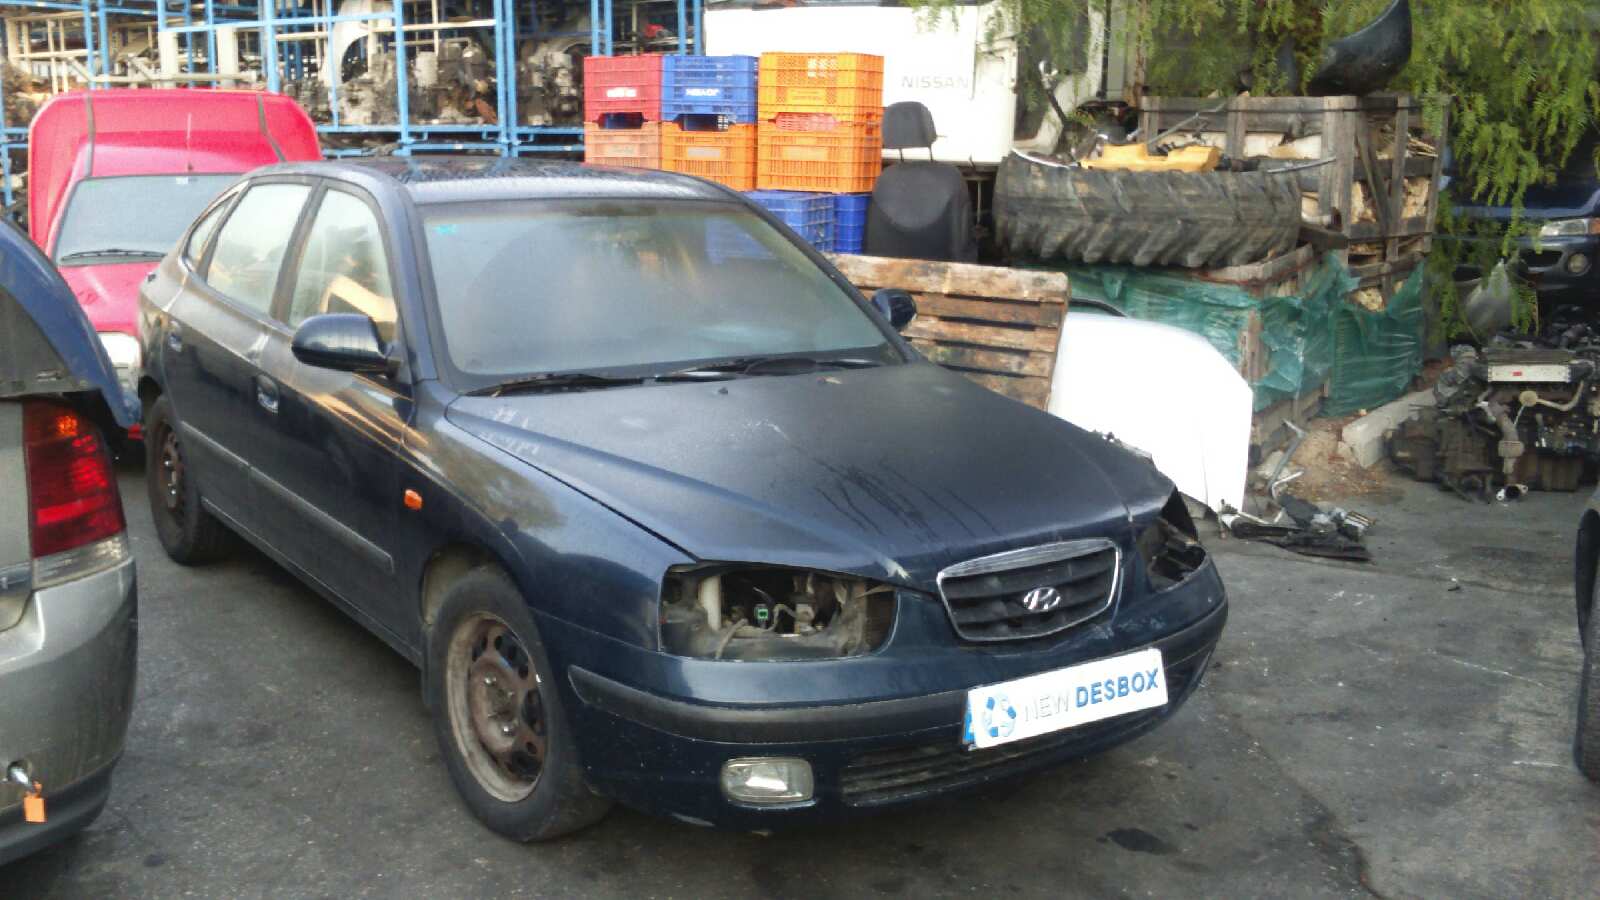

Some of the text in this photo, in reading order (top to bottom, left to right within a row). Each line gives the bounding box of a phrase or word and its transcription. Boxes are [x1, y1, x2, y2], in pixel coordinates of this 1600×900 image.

[901, 75, 969, 89] NISSAN
[1024, 667, 1159, 722] NEW DESBOX
